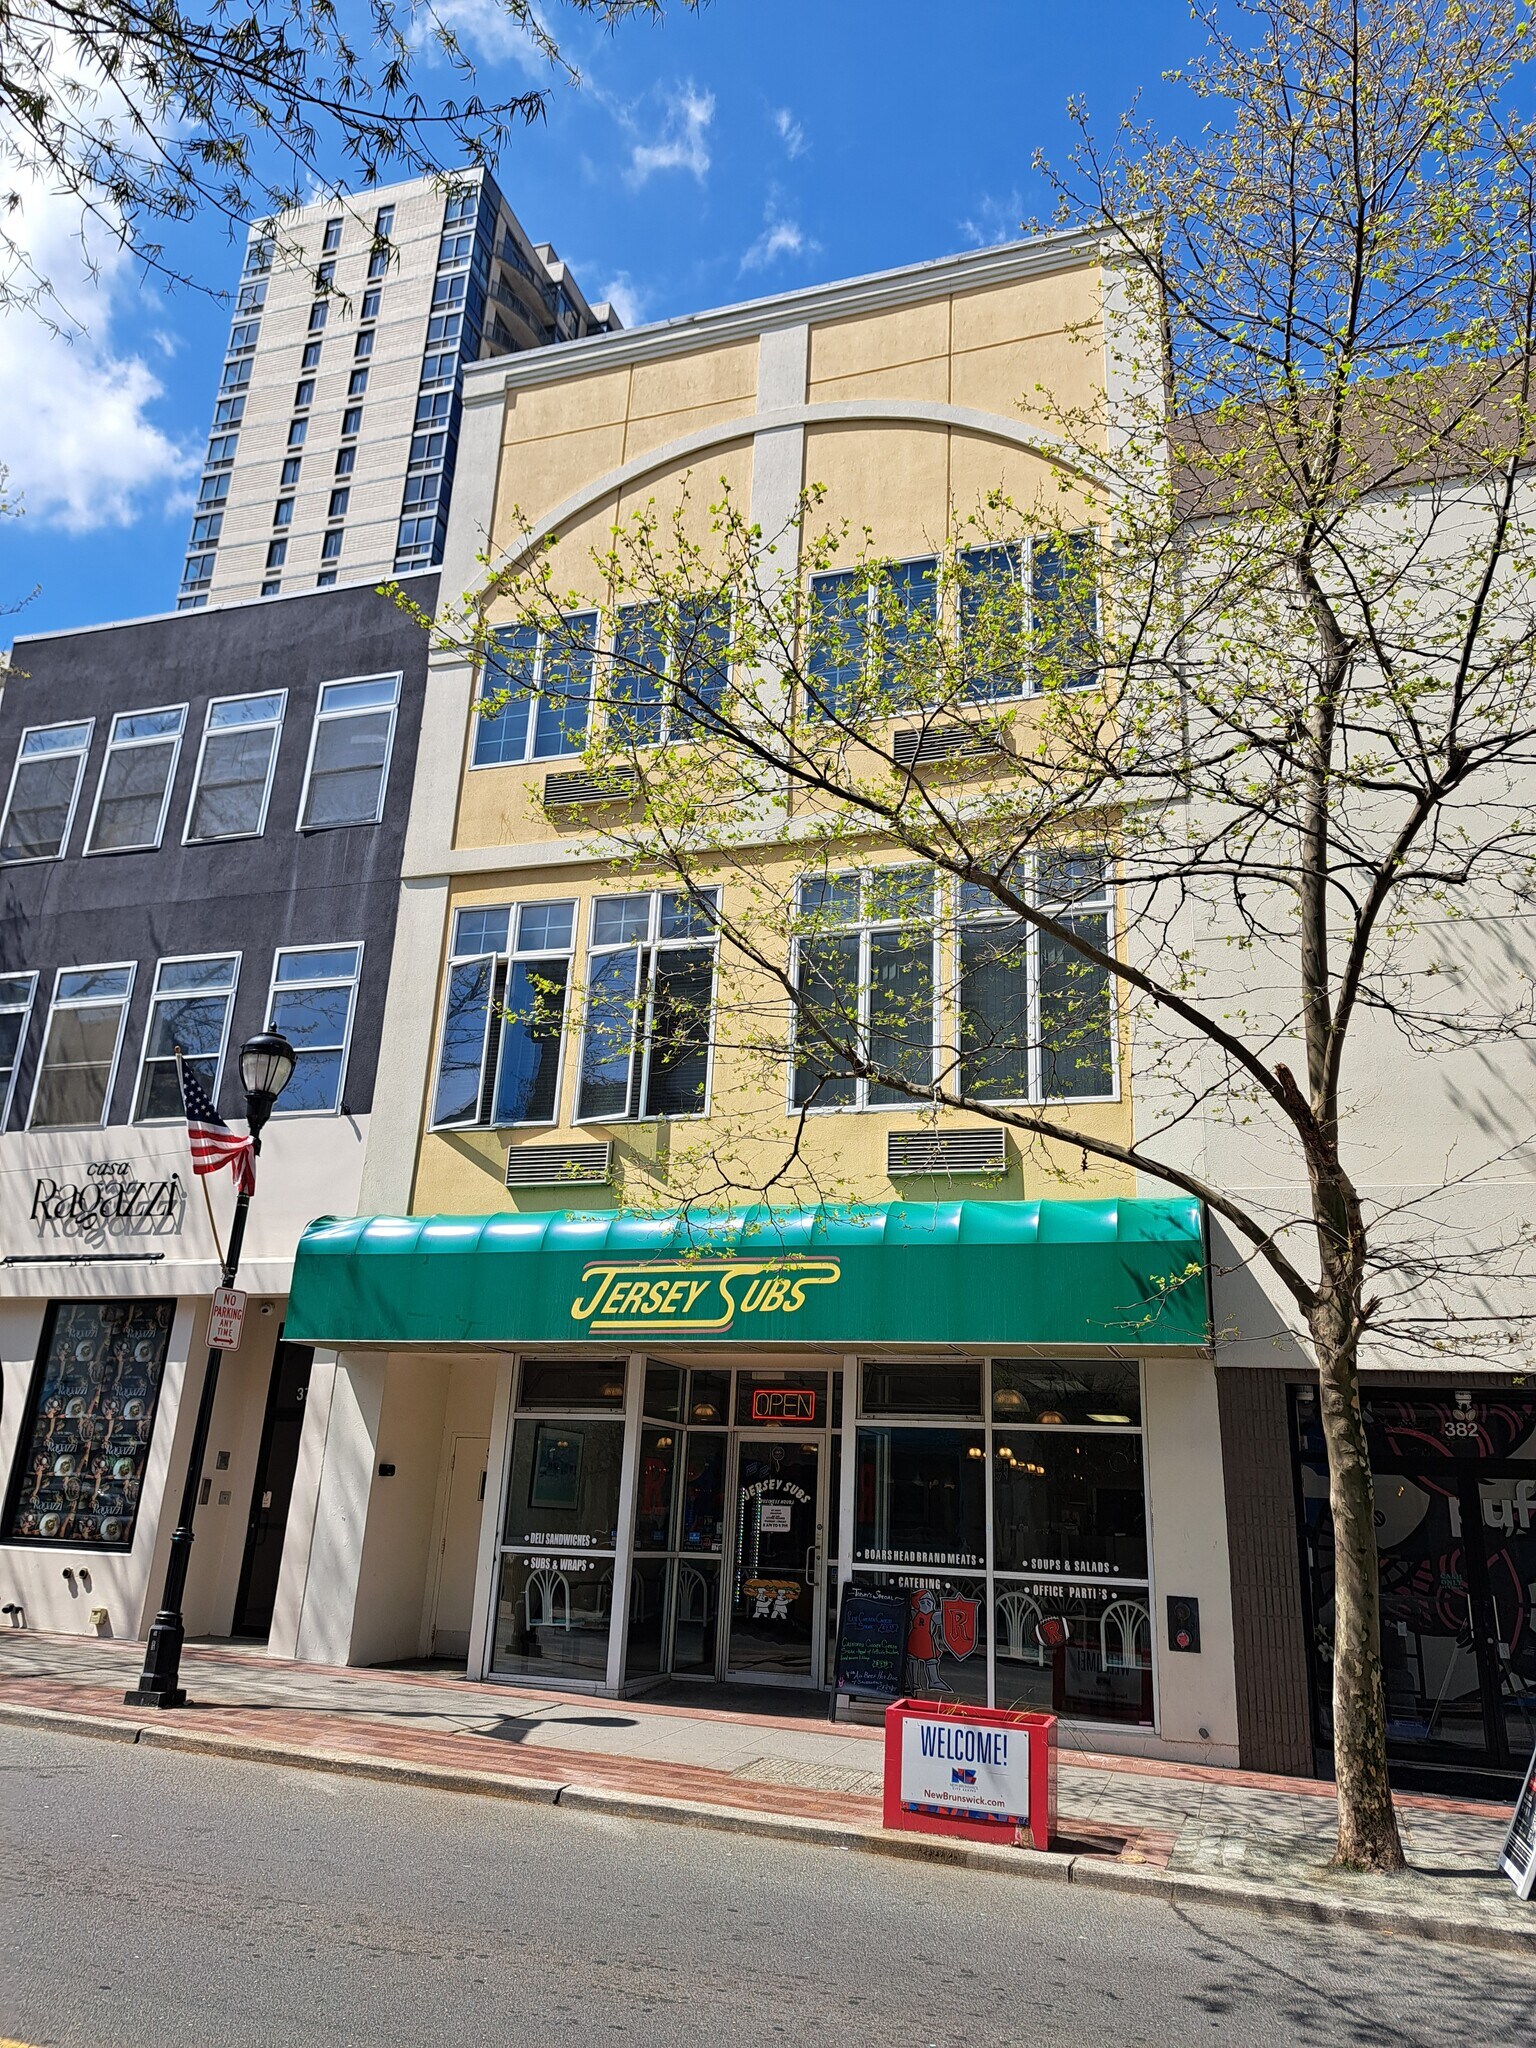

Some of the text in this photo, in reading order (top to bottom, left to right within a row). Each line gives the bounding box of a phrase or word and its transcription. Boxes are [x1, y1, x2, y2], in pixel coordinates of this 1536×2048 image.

[87, 1162, 129, 1176] casa
[30, 1173, 178, 1230] Ragazzi
[224, 1294, 236, 1306] NO
[571, 1263, 841, 1327] JERSEY SUBS
[213, 1305, 242, 1320] PARKING
[219, 1319, 233, 1328] ANY
[217, 1328, 233, 1337] TIME
[296, 1387, 309, 1401] 3
[755, 1393, 812, 1417] OPEN
[1445, 1422, 1479, 1437] 382
[744, 1479, 811, 1503] JERSEY SUBS
[530, 1532, 591, 1547] DELI SANDWICHES
[530, 1557, 587, 1572] SUBS & WRAPS
[1031, 1558, 1110, 1573] SOUPS & SALADS
[898, 1577, 941, 1590] CATERING
[1032, 1584, 1108, 1600] OFFICE PARTIS
[1043, 1620, 1063, 1646] R
[920, 1725, 1008, 1767] WELCOME!
[924, 1789, 1005, 1808] NewBrunswick.com
